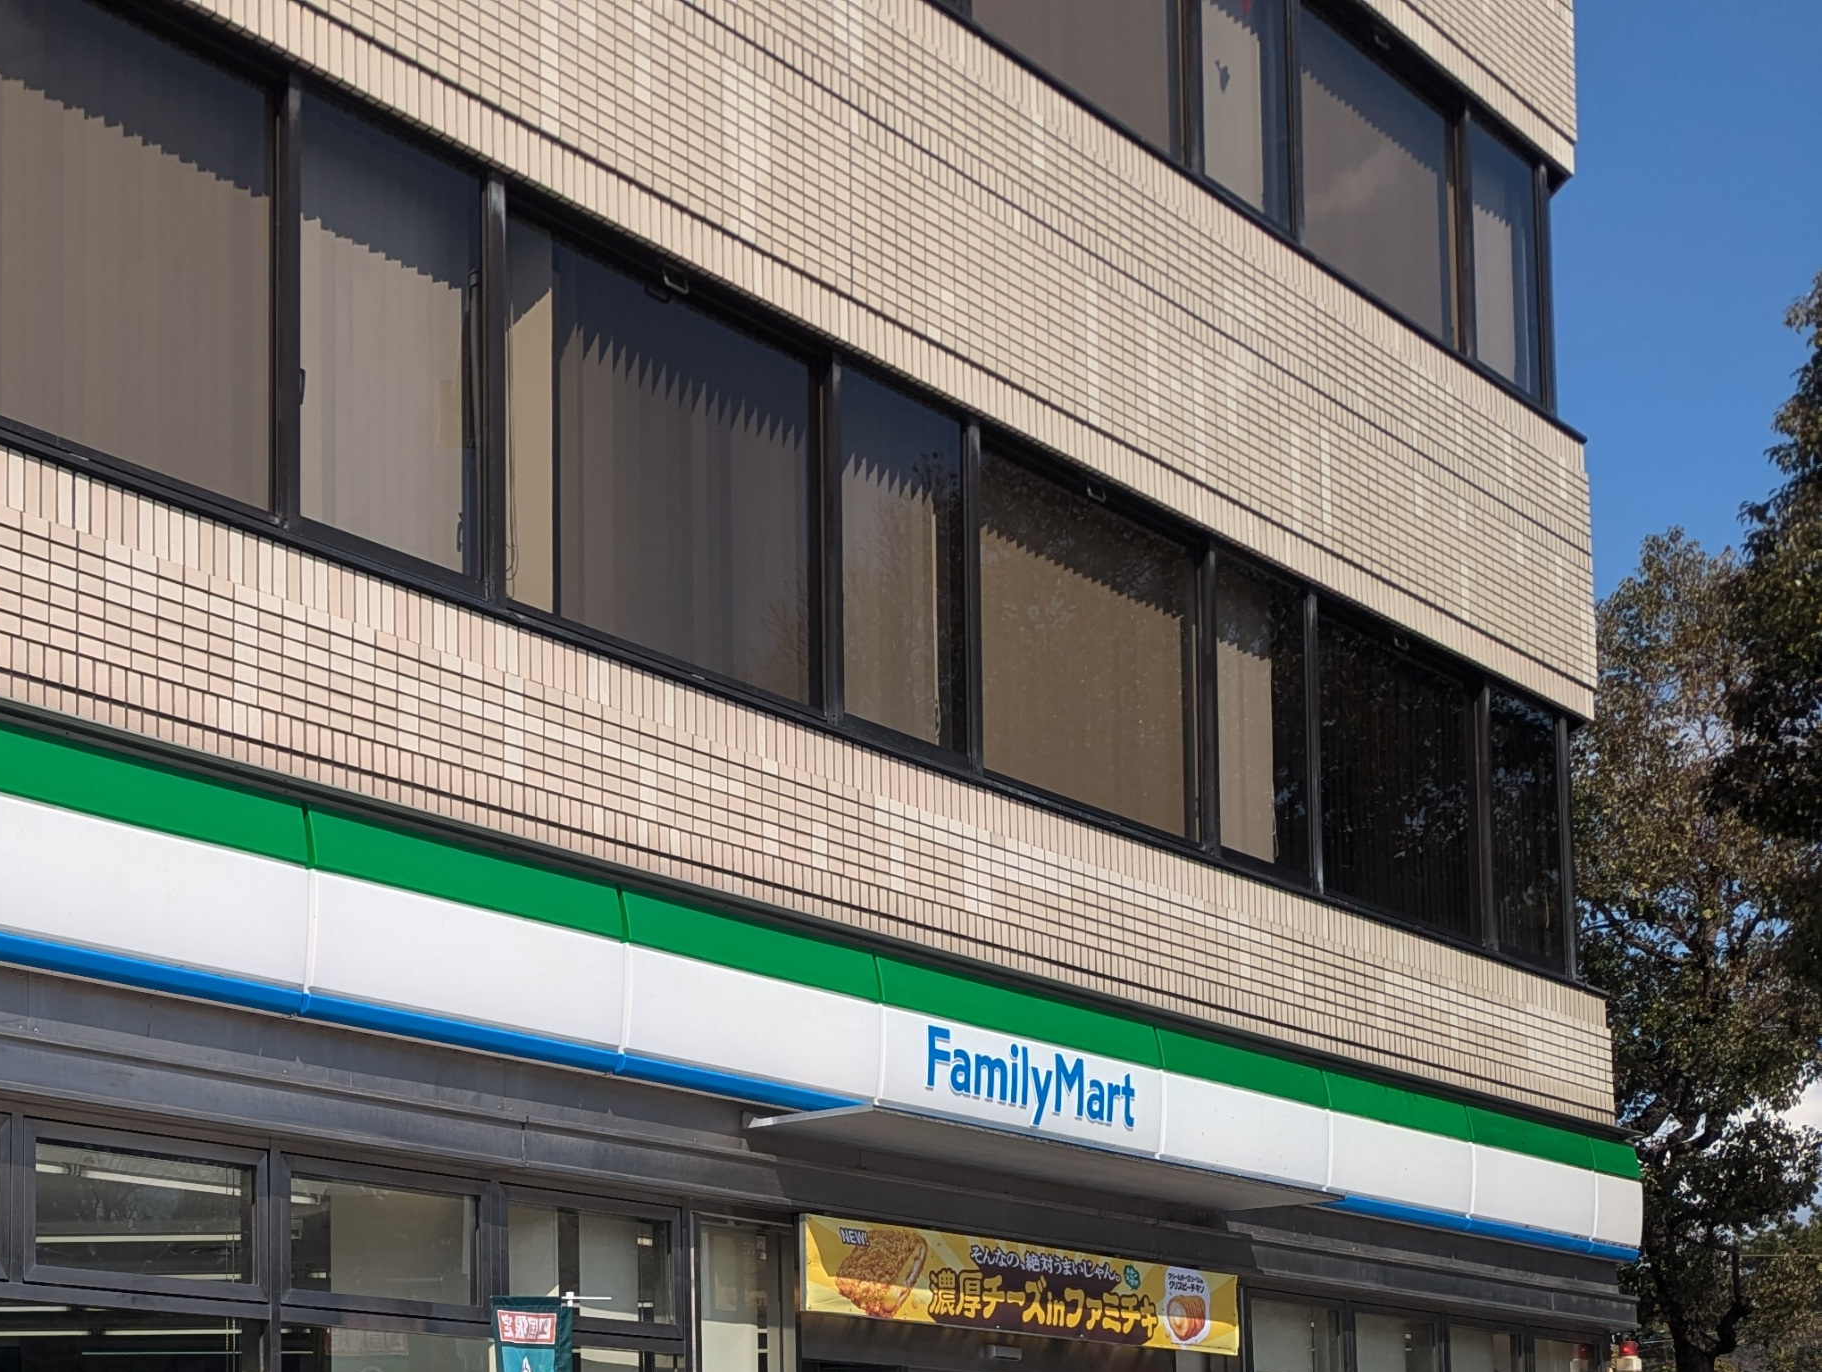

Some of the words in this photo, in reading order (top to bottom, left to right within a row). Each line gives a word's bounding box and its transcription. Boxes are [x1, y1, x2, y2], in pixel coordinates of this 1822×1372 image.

[926, 1024, 1135, 1129] FamilyMart
[840, 1228, 870, 1247] NEW!
[969, 1245, 1121, 1282] そんなの、絶対うまいじゃん。
[928, 1270, 1158, 1338] 濃厚チーズinファミチキ
